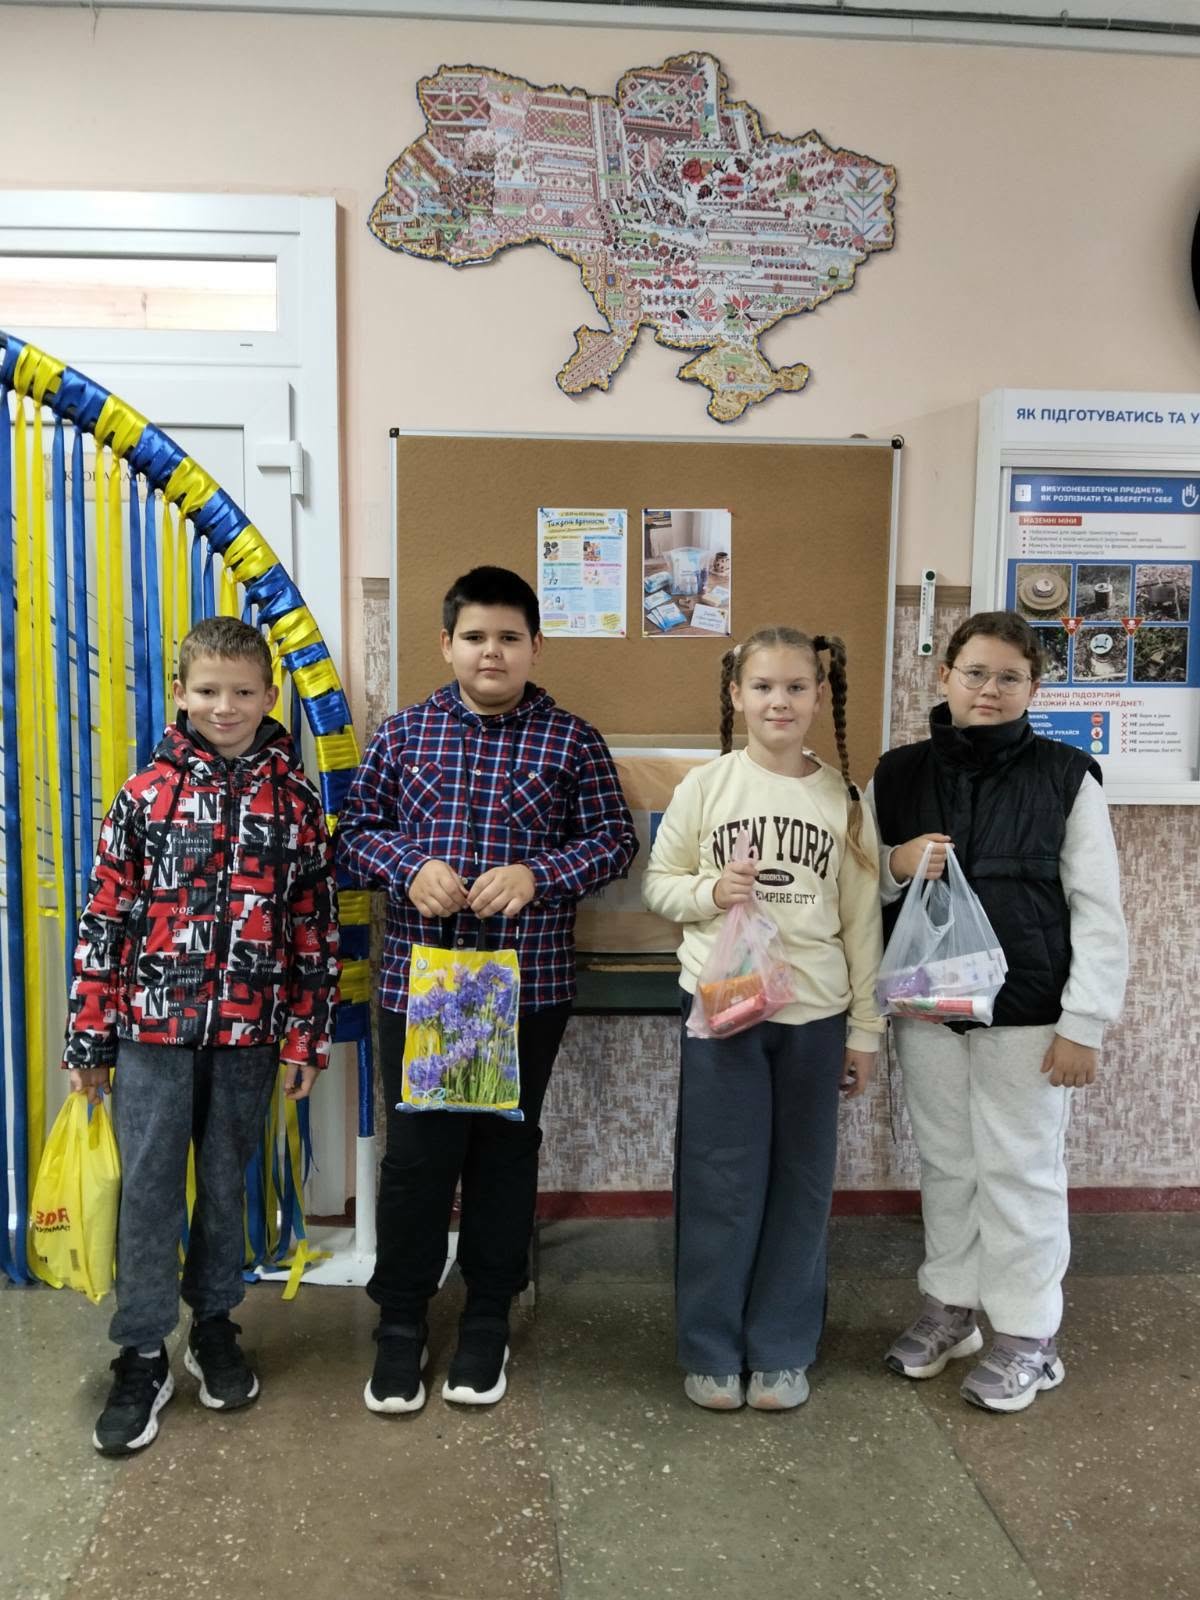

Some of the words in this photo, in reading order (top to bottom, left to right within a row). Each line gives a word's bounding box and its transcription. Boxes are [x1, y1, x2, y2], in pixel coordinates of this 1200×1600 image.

[1016, 408, 1036, 420] ЯК
[1041, 408, 1164, 423] ПІДГОТУВАТИСЬ
[1168, 412, 1186, 424] ТА
[1040, 485, 1118, 494] ВИБУХОНЕБЕЗПЕЧНІ
[1023, 517, 1056, 525] НАЗЕМНІ
[1058, 517, 1077, 525] МІНИ
[1041, 691, 1070, 699] БАЧИШ
[1072, 691, 1121, 700] ПІДОЗРІЛИЙ
[712, 816, 767, 872] NEW
[773, 816, 834, 880] YORK
[755, 890, 793, 904] EMPIRE
[794, 893, 816, 905] CITY
